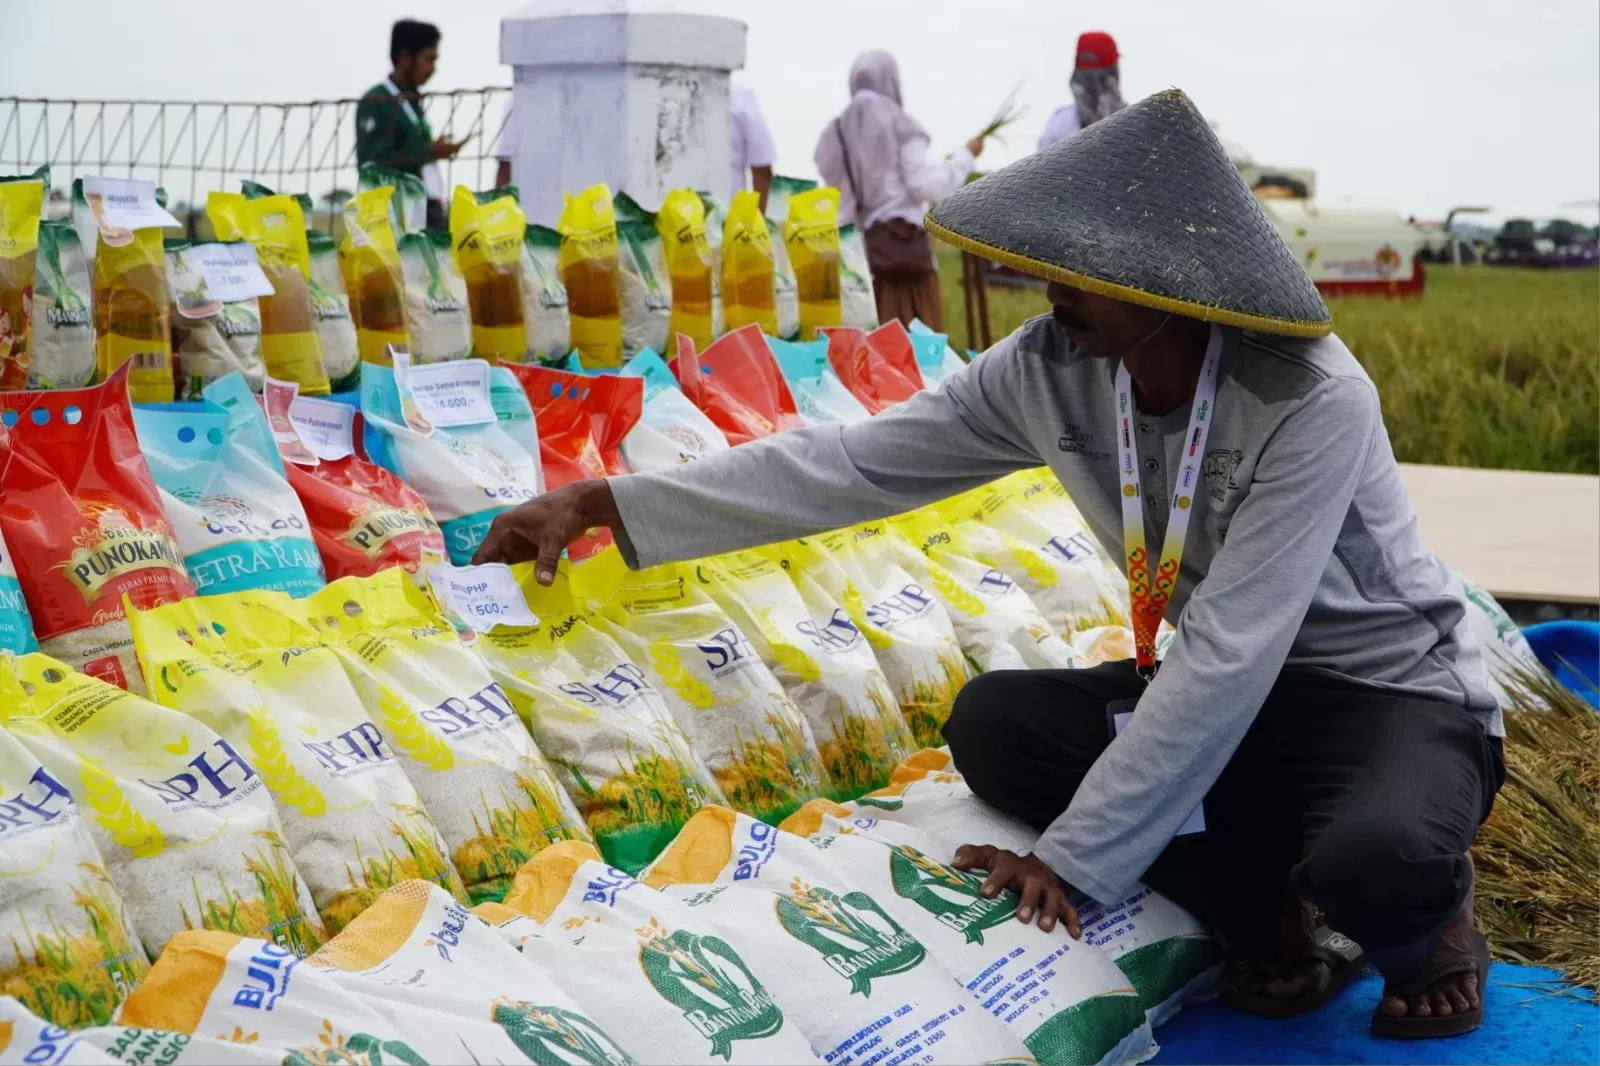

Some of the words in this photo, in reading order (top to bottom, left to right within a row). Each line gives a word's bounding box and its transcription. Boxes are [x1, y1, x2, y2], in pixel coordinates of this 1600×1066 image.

[73, 540, 184, 588] PUNOKAWAN
[466, 582, 488, 595] PHP
[82, 646, 105, 657] CARA
